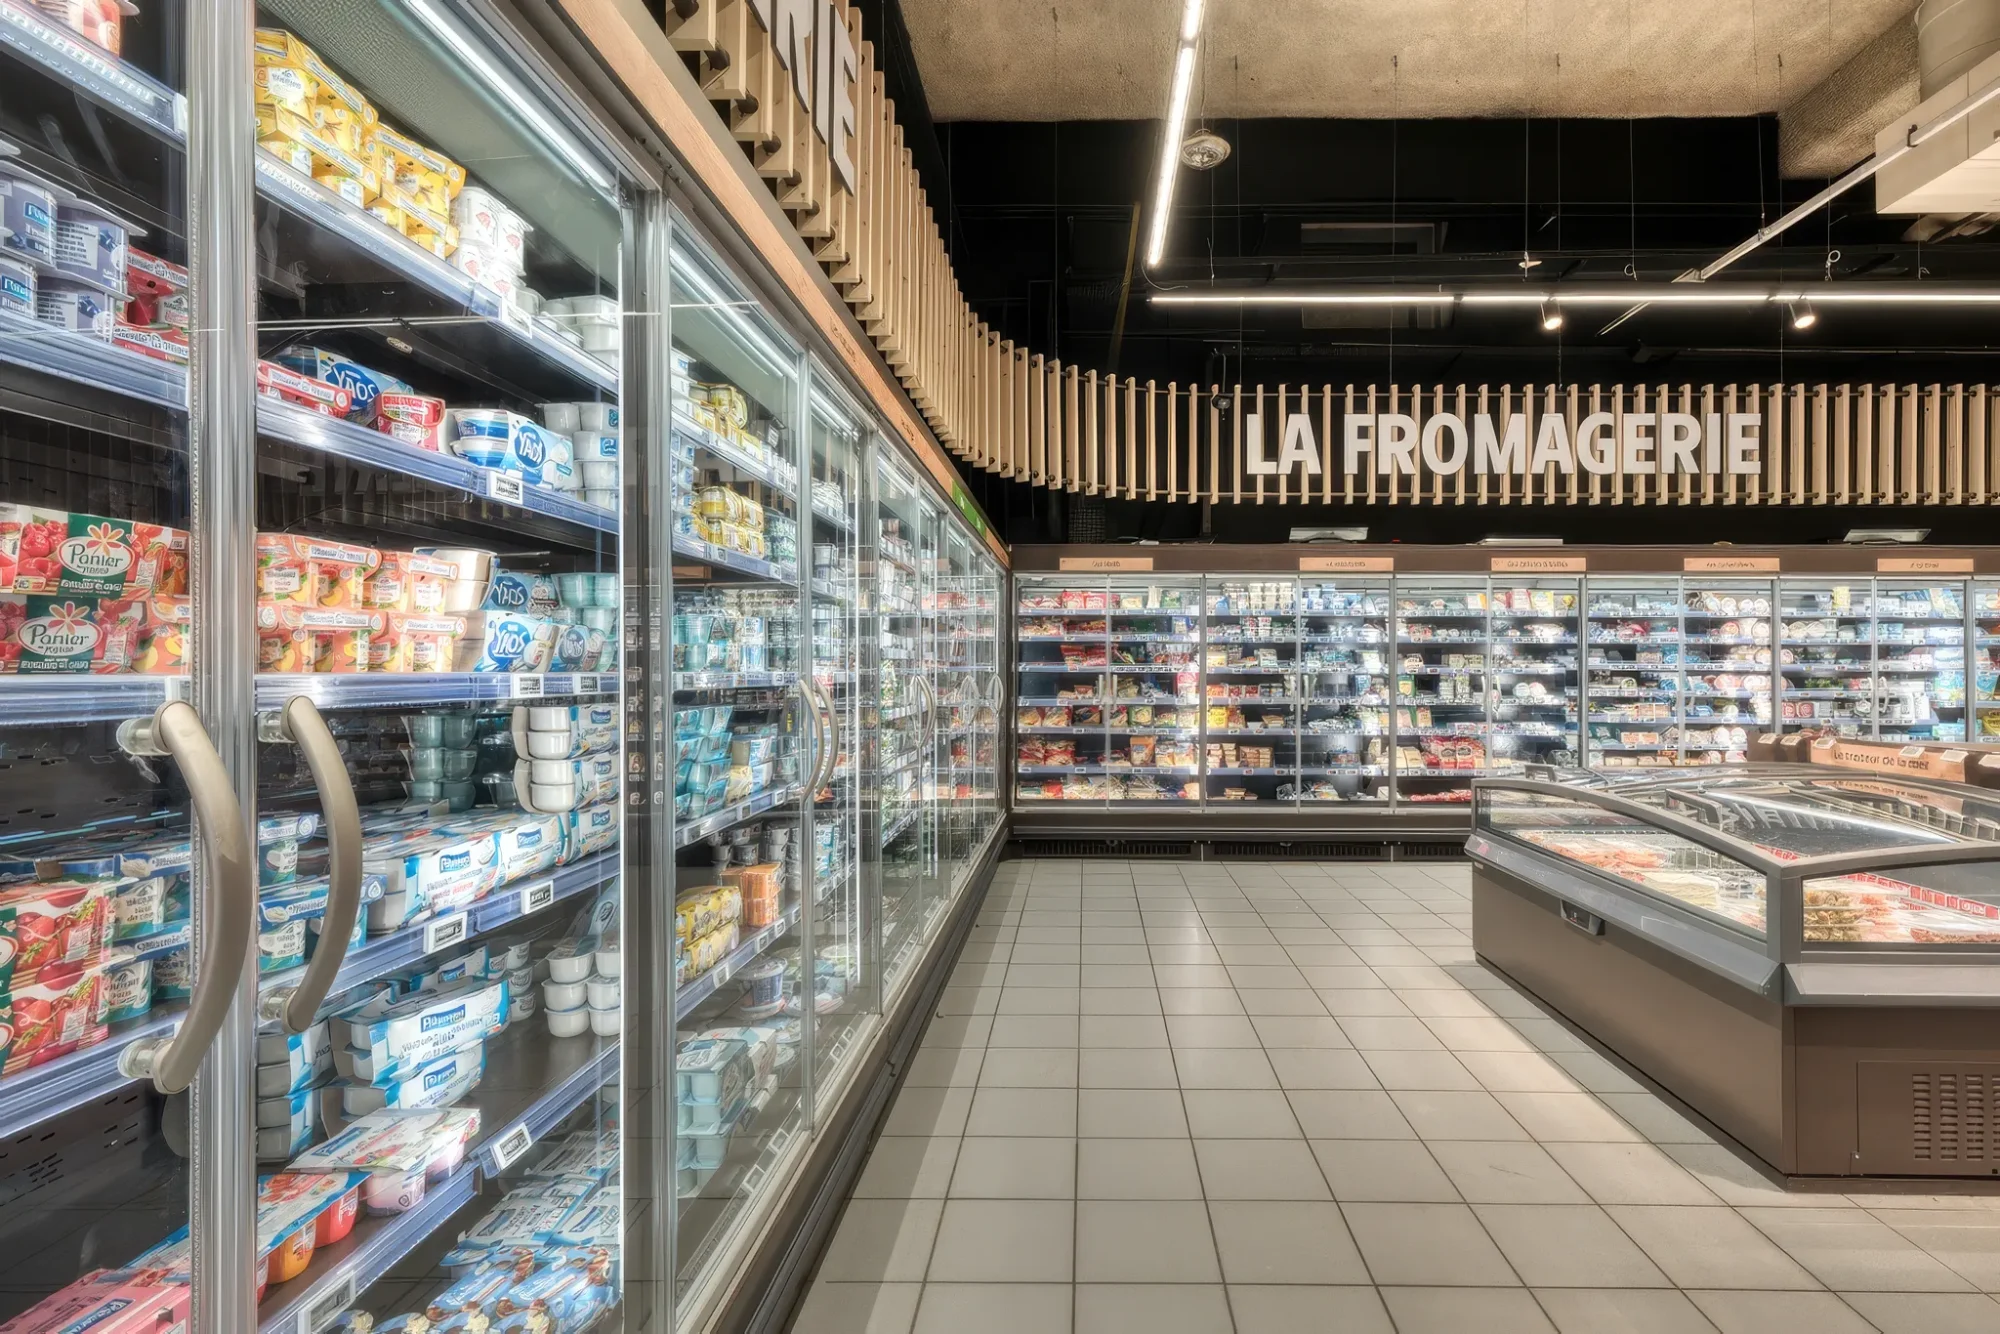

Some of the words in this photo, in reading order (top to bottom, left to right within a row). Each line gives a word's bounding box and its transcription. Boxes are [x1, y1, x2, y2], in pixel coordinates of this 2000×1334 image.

[1246, 413, 1321, 475] LA
[1344, 412, 1762, 476] FROMAGERIE
[68, 543, 124, 568] Panier
[26, 626, 90, 647] Panier
